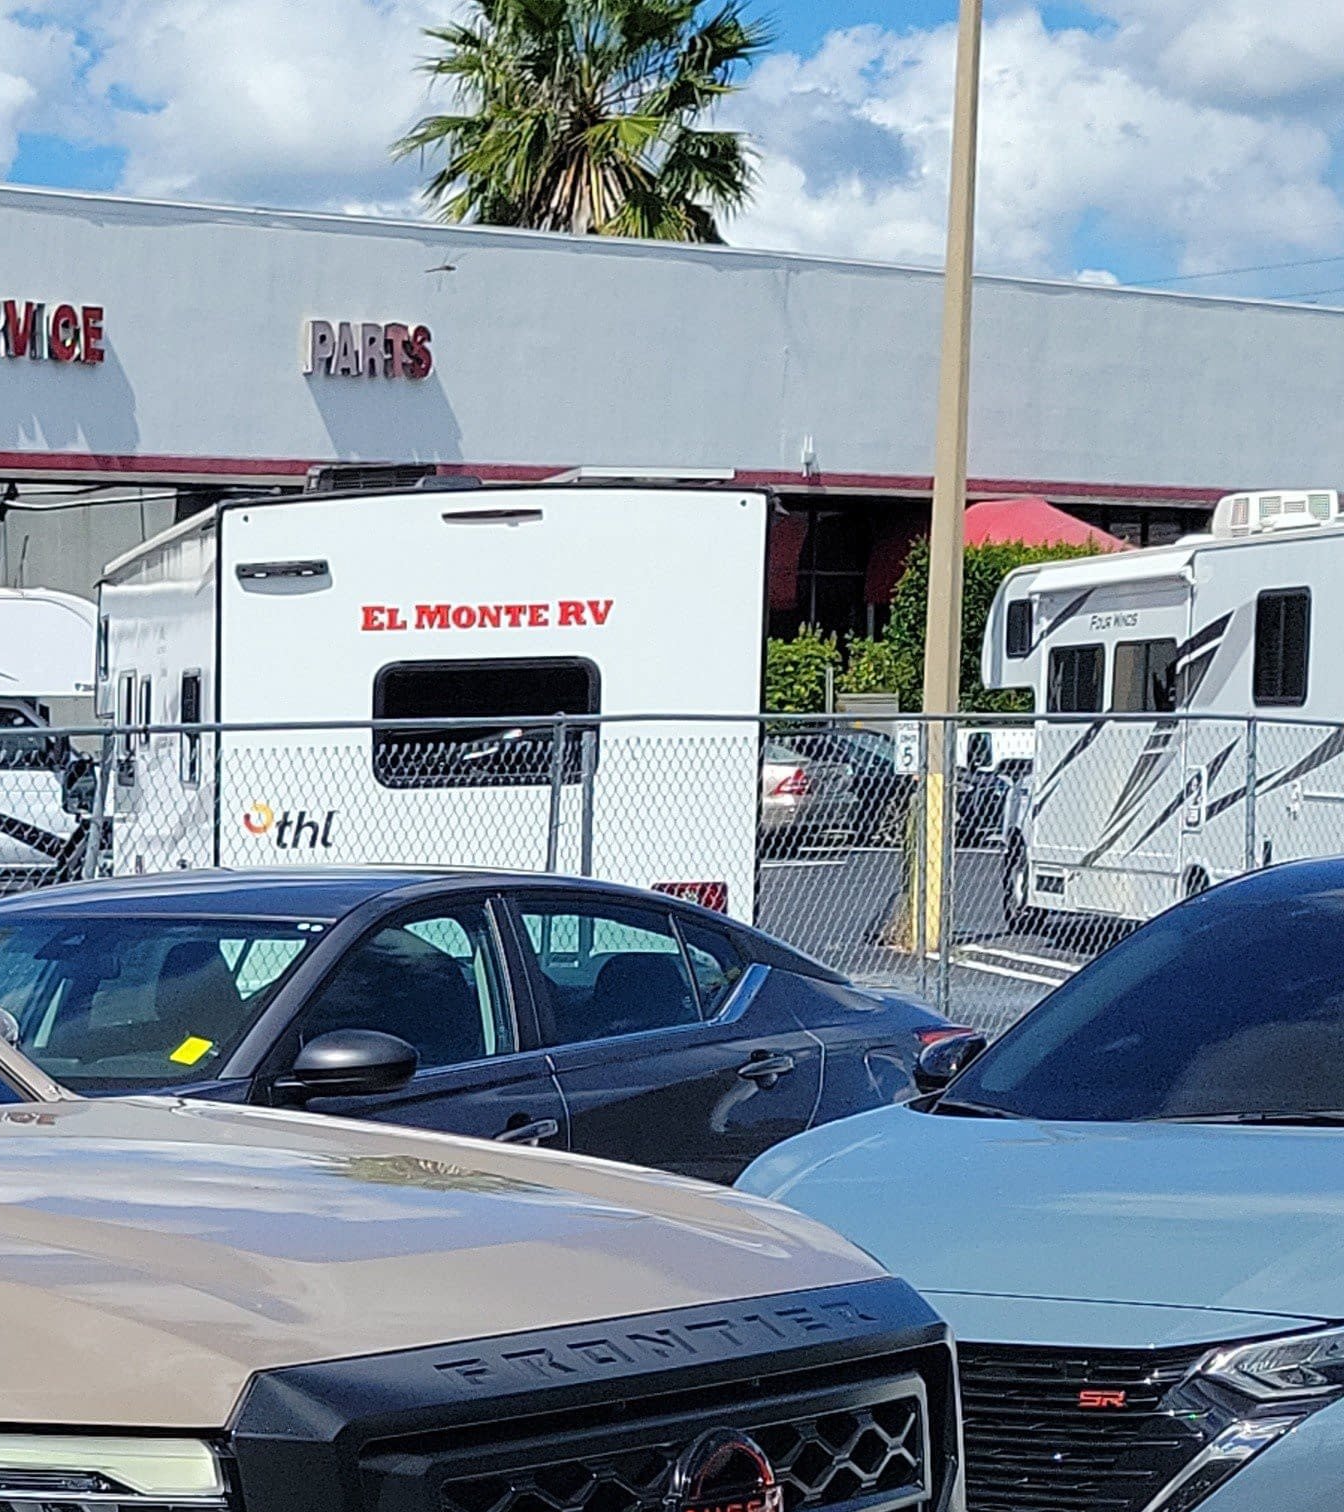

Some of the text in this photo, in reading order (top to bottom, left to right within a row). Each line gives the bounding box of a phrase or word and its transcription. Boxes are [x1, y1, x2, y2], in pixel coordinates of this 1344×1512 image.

[306, 319, 433, 379] PARTS
[361, 599, 615, 632] EL MONTE RV
[902, 746, 913, 767] 5
[276, 809, 339, 849] thl
[432, 1300, 882, 1387] FRONTIER
[1078, 1390, 1126, 1408] SR
